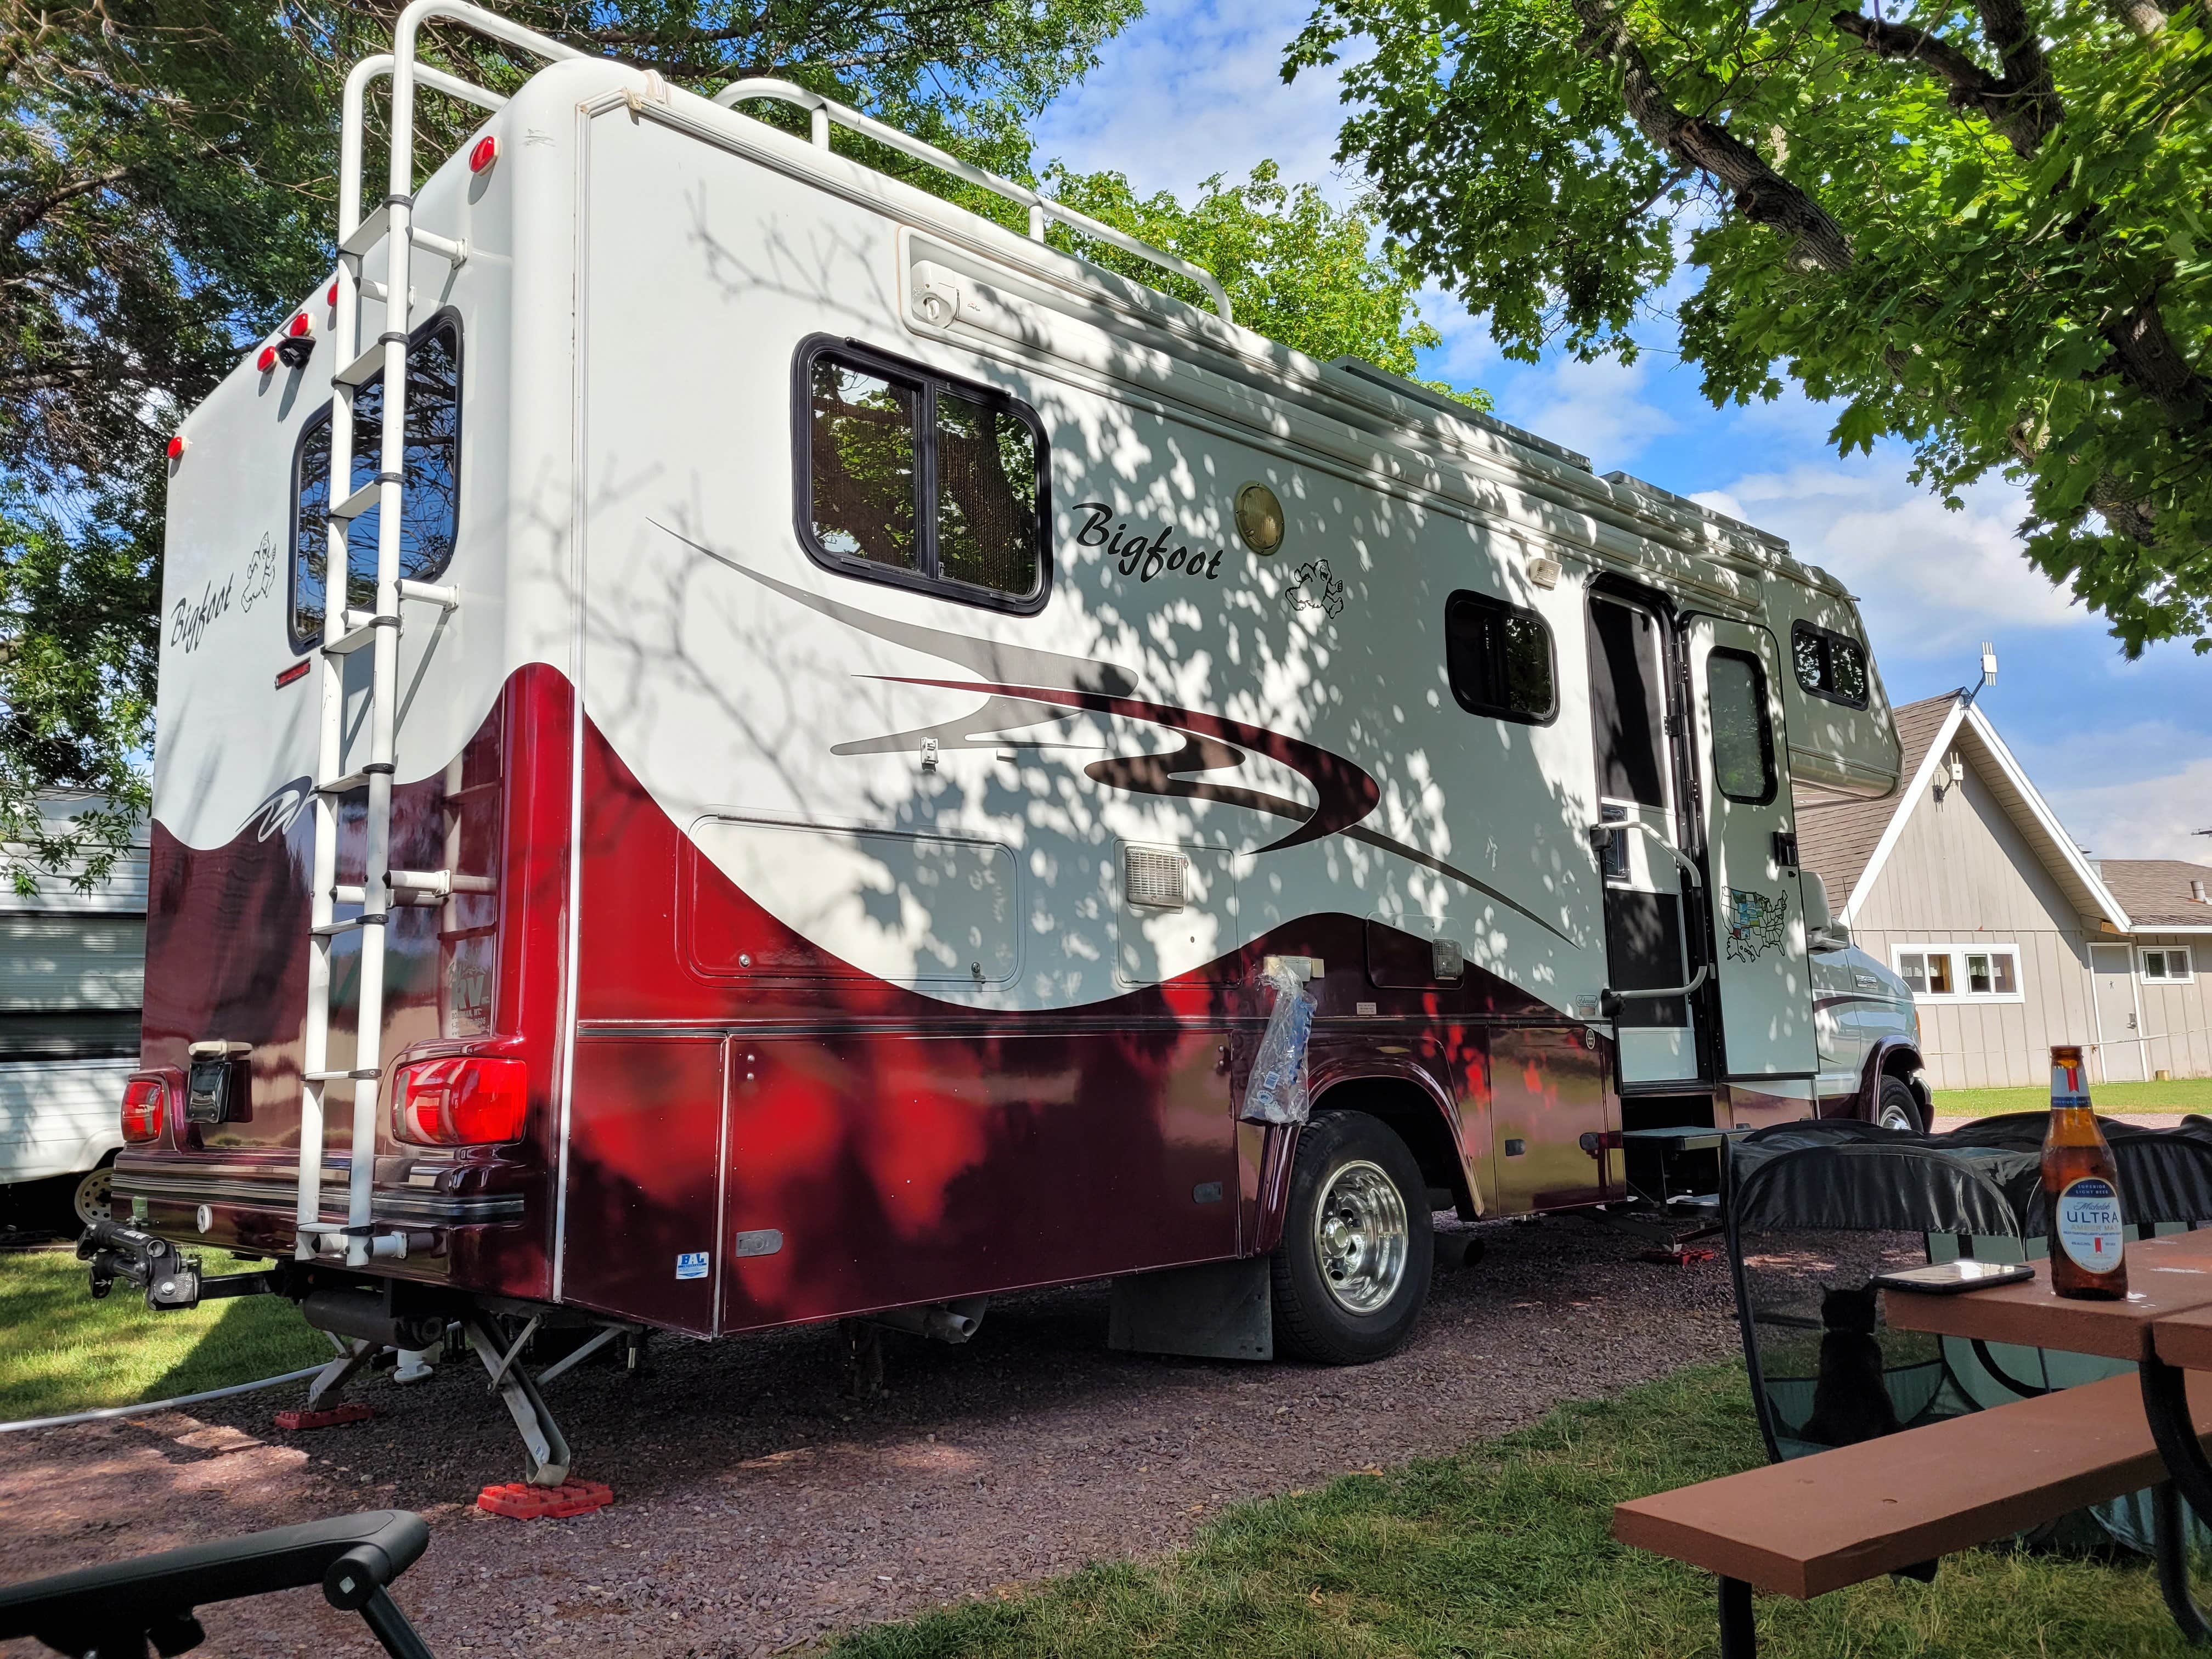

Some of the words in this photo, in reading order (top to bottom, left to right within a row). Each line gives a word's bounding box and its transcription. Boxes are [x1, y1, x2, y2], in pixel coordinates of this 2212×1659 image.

[1071, 502, 1223, 583] Bigfoot
[171, 572, 234, 654] Bigfoot
[451, 975, 485, 1011] RV
[2066, 1211, 2119, 1223] ULTRA
